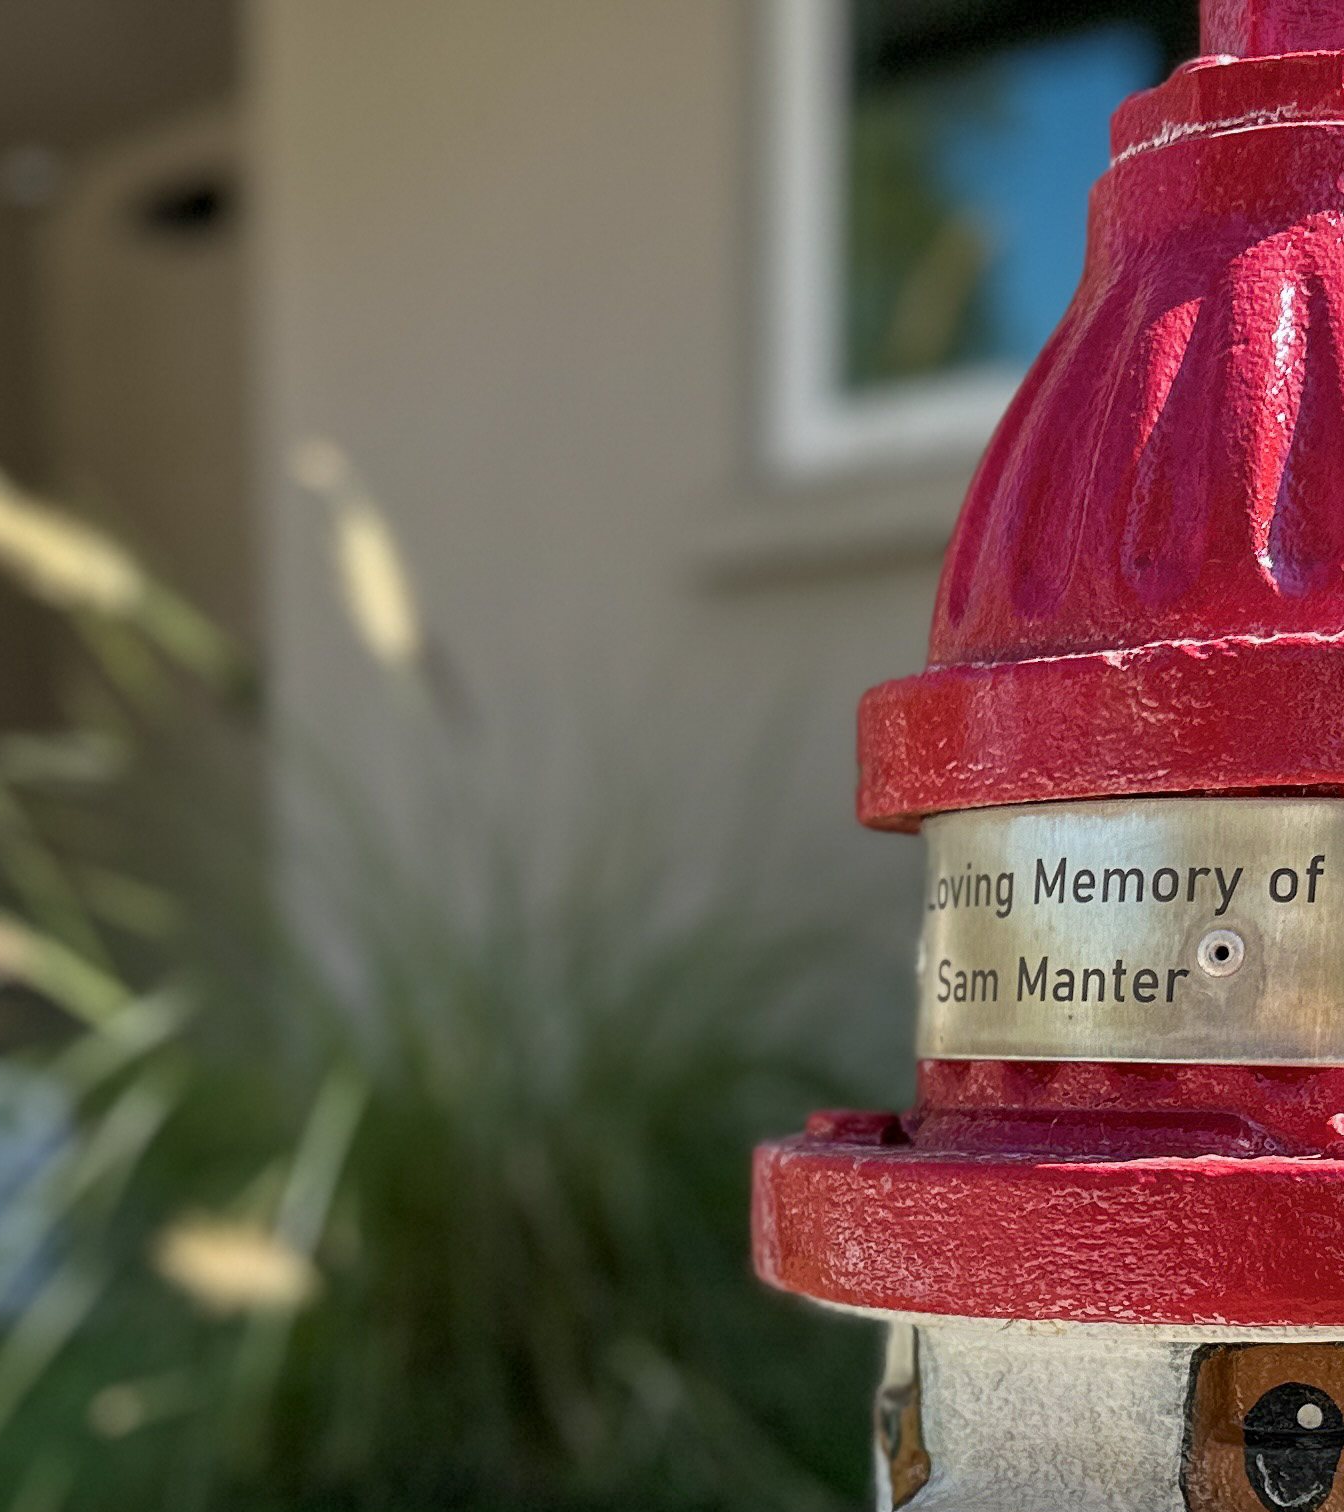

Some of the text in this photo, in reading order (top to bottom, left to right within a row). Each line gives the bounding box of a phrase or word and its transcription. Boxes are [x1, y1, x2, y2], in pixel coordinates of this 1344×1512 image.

[1033, 857, 1243, 916] Memory
[1268, 855, 1325, 904] of
[937, 956, 1190, 1003] Sam Manter
